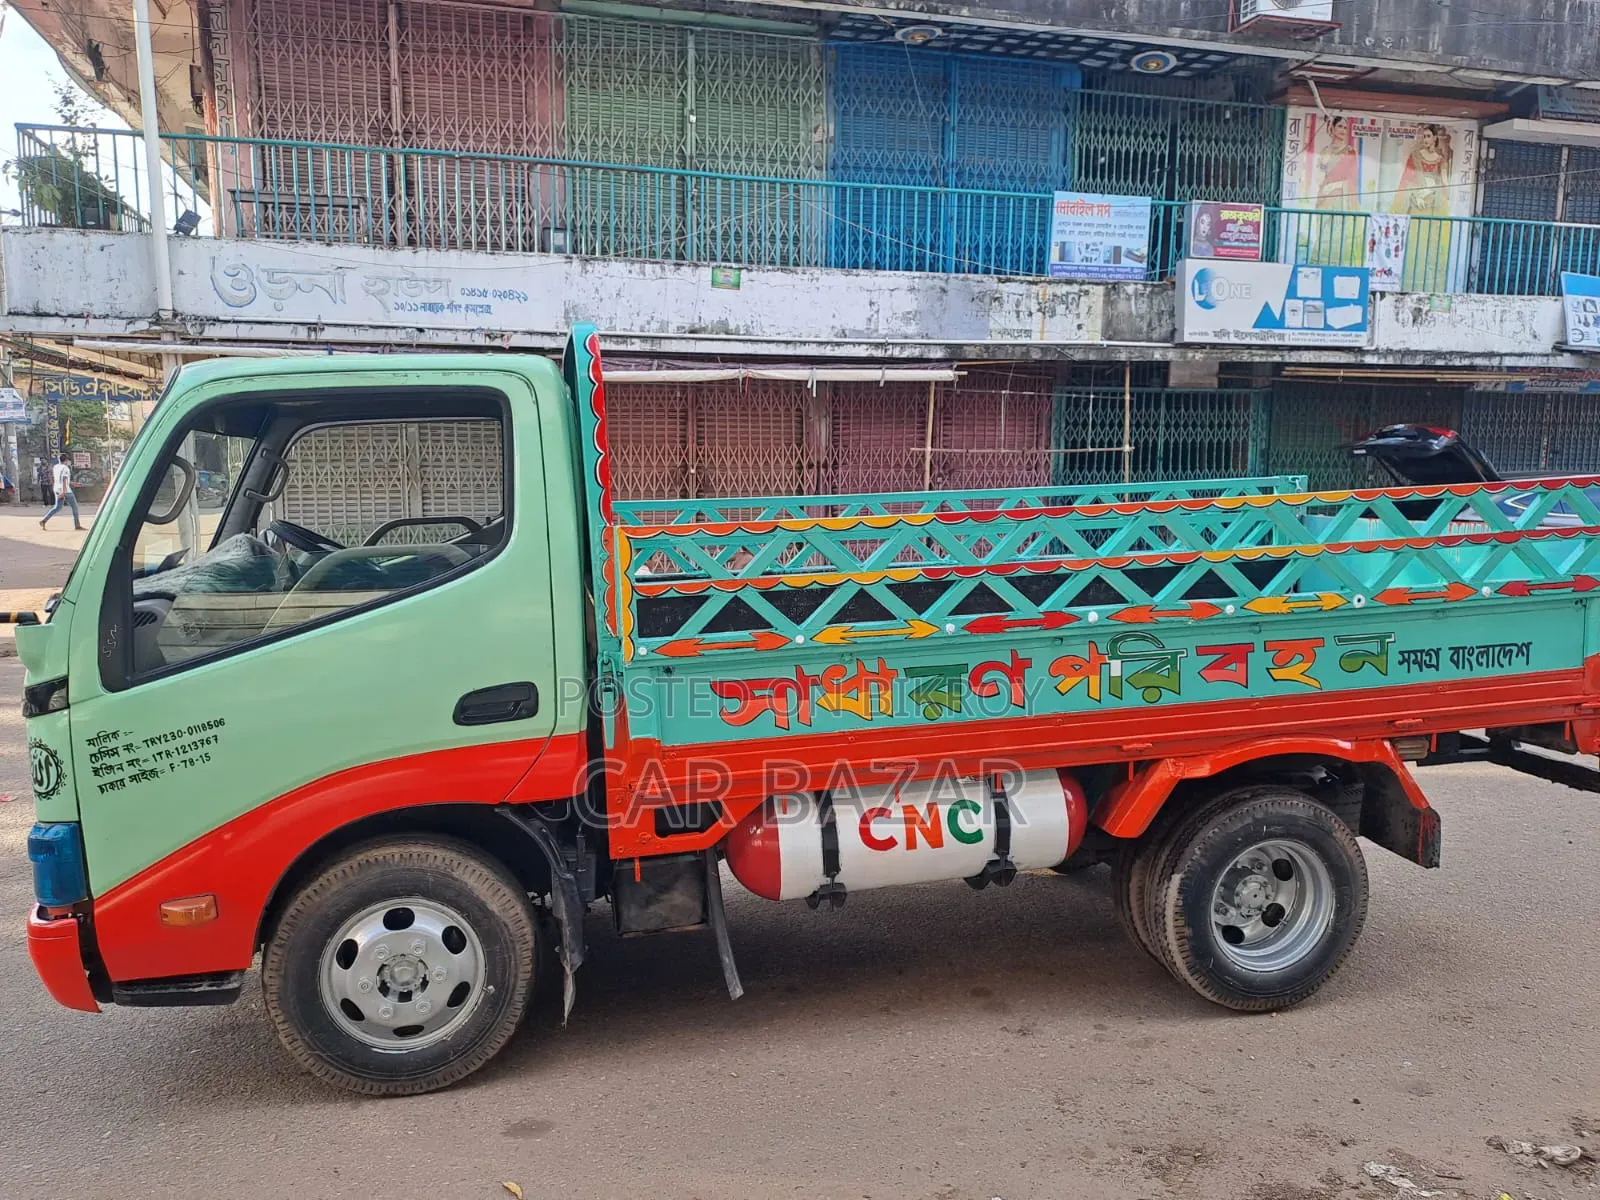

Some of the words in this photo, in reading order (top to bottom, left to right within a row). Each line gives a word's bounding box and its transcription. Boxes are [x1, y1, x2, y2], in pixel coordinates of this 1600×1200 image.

[709, 648, 1033, 731] সাধারণ
[1398, 647, 1442, 674] সমগ্র
[1448, 640, 1533, 672] বাংলাদেশ
[86, 730, 121, 748] মালিক
[89, 746, 121, 764] চেসিস
[97, 777, 126, 795] চাকার
